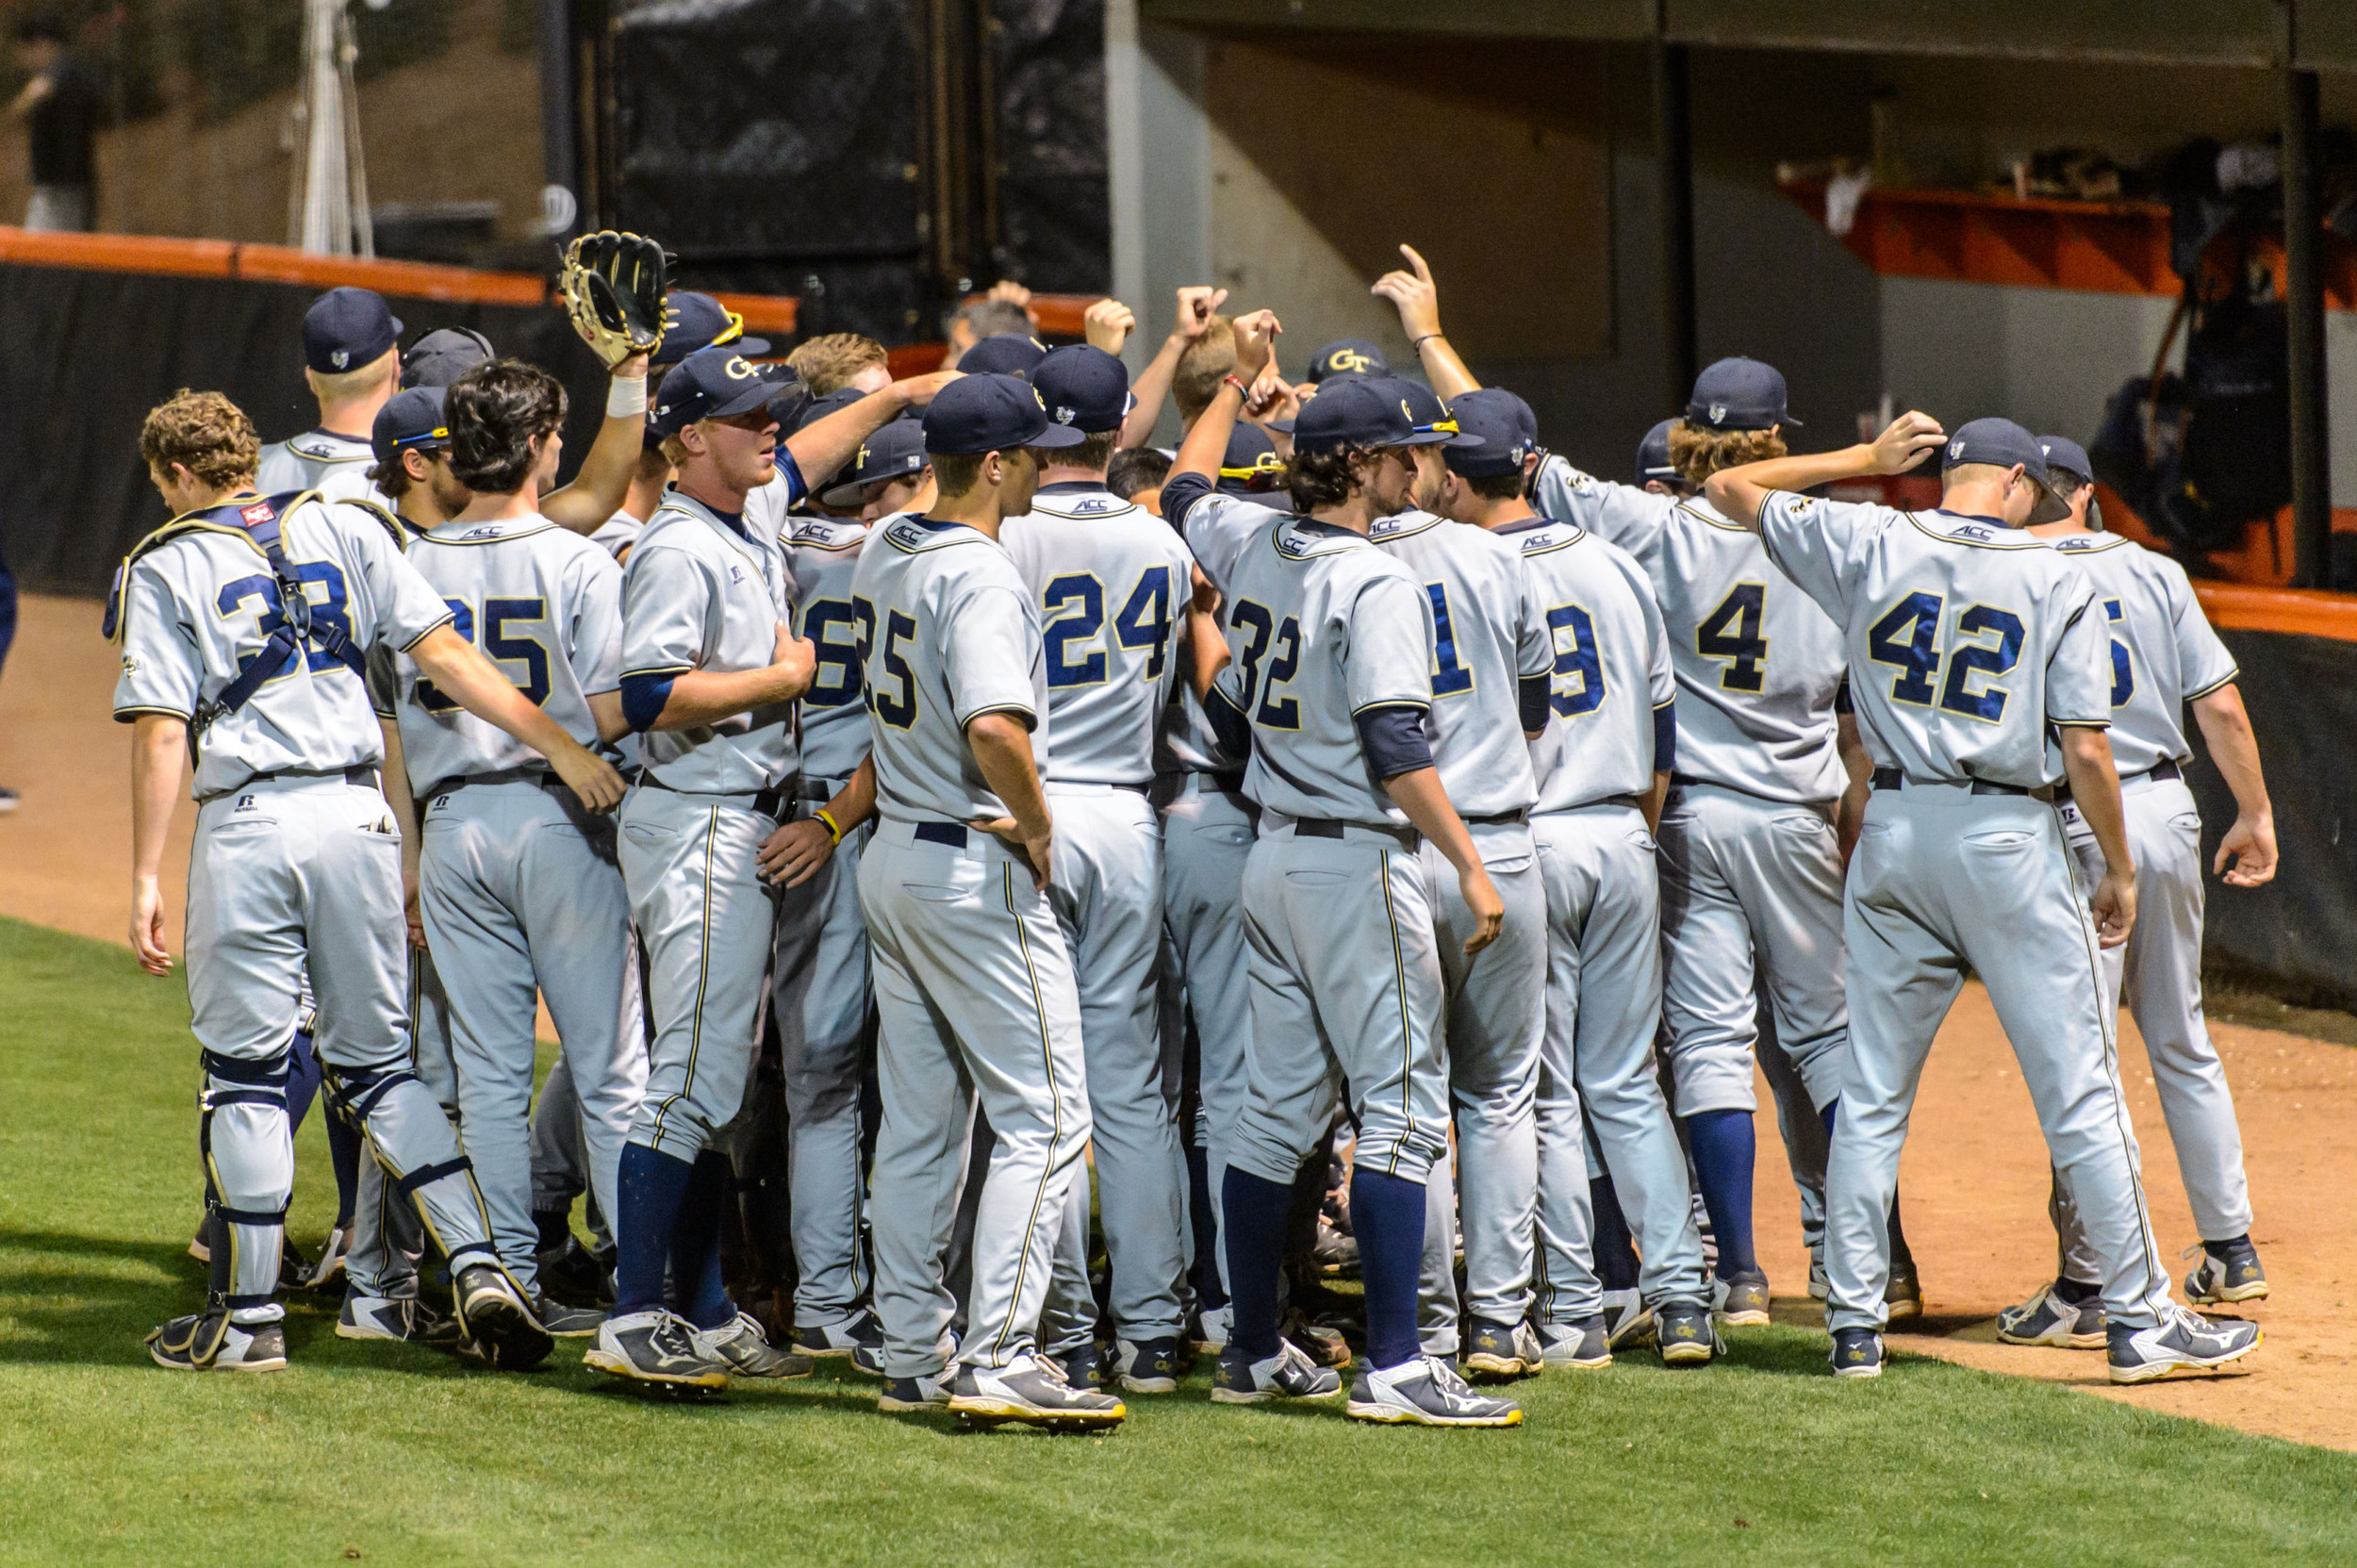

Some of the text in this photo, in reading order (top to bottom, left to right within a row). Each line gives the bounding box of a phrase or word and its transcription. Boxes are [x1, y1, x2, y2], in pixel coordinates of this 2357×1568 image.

[1328, 348, 1370, 373] GT
[1071, 499, 1108, 513] ACC
[459, 526, 503, 539] ACC
[792, 522, 834, 542] ACC
[891, 524, 925, 545] ACC
[1521, 533, 1553, 549] ACC
[1948, 525, 1995, 541] ACC
[1283, 537, 1310, 554] CC
[2055, 538, 2091, 550] ACC
[1043, 566, 1172, 688] 24
[1697, 582, 1769, 694] 4
[1229, 596, 1303, 732] 32
[1868, 589, 2028, 724] 42
